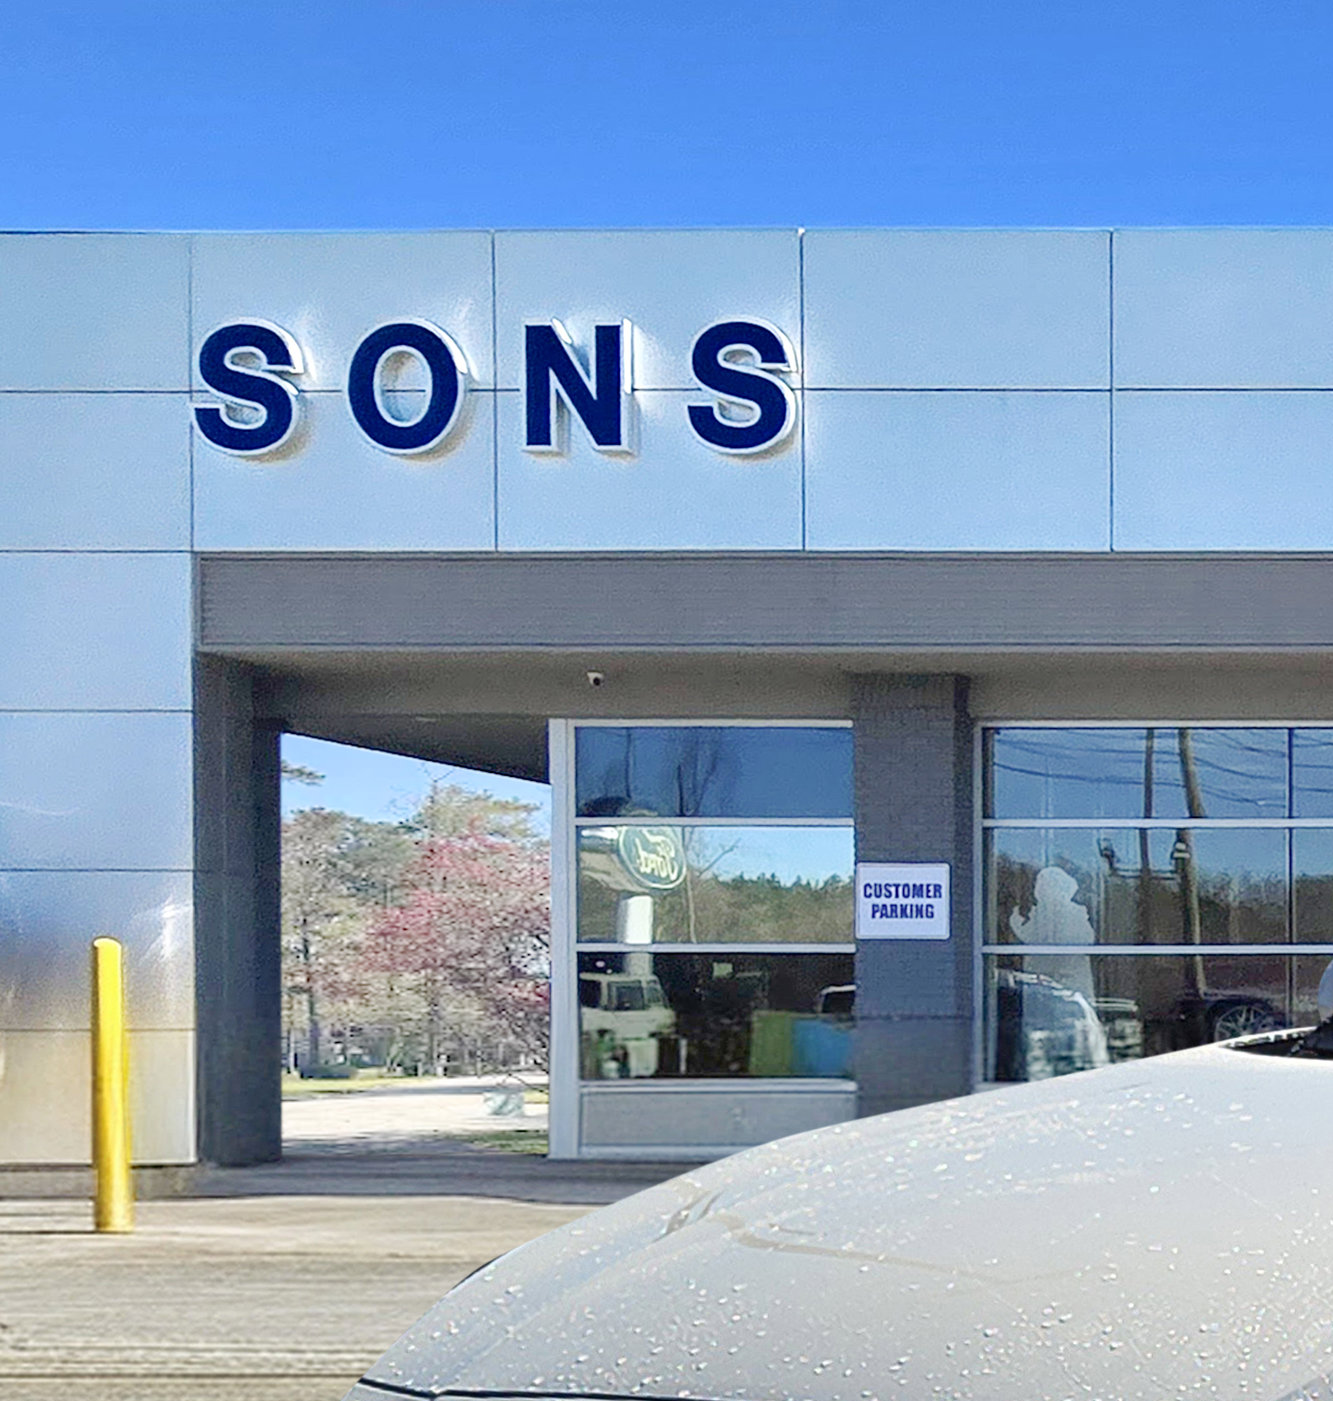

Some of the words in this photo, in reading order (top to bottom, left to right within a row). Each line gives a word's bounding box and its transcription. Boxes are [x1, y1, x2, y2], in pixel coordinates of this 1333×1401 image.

[194, 320, 790, 451] SONS
[863, 882, 943, 899] CUSTOMER
[871, 903, 935, 919] PARKING
